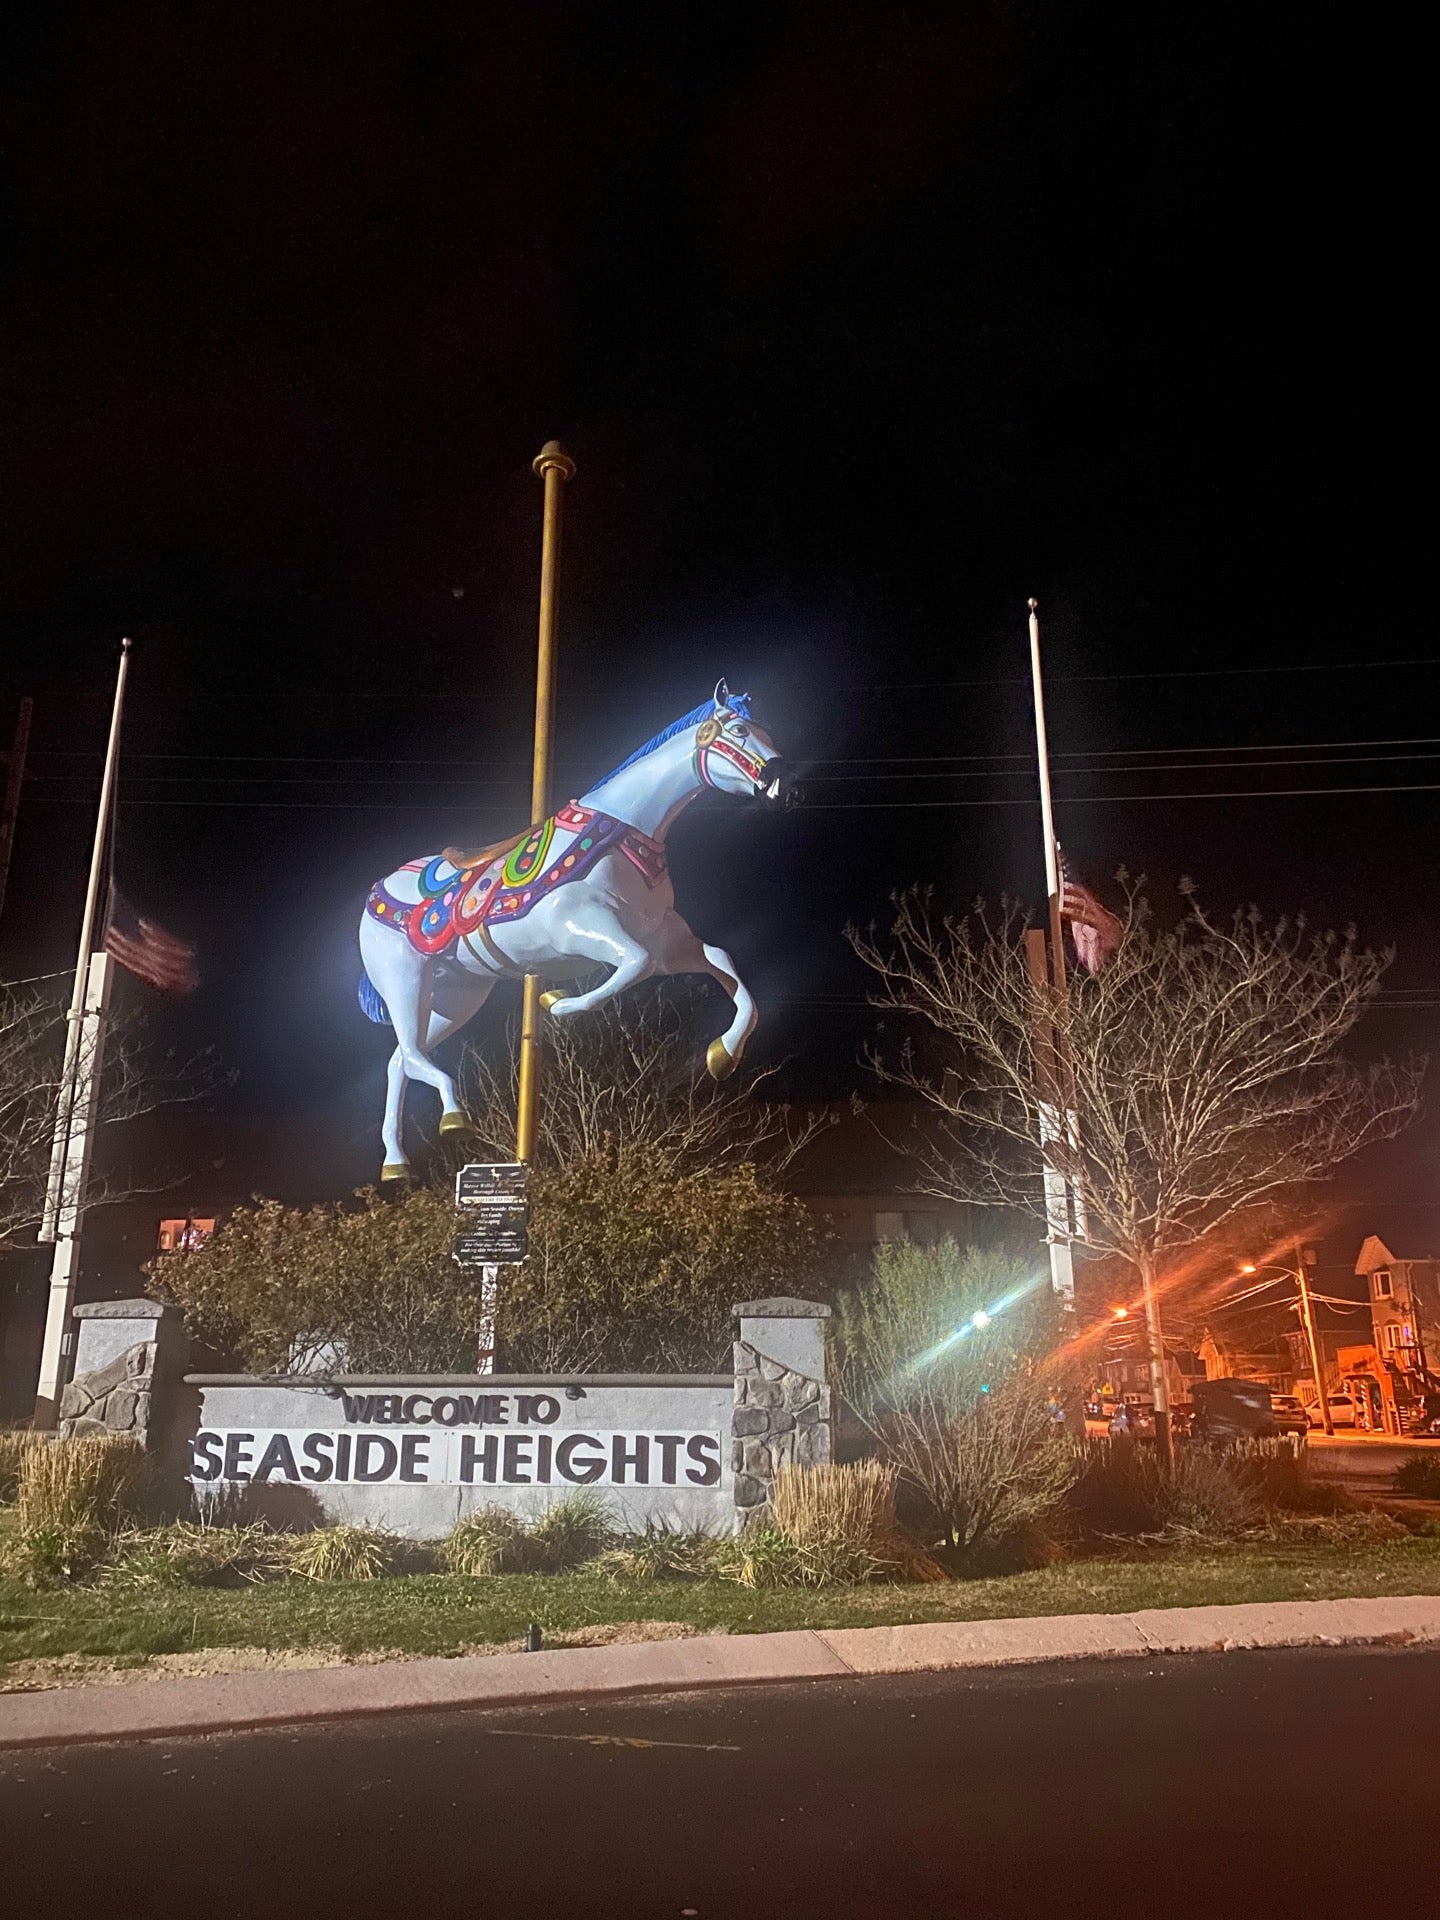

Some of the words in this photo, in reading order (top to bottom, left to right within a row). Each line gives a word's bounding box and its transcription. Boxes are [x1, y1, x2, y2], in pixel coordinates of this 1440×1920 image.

[343, 1394, 508, 1425] WELCOME
[514, 1394, 562, 1424] TO
[191, 1432, 430, 1483] SEASIDE
[460, 1433, 721, 1486] HEIGHTS
